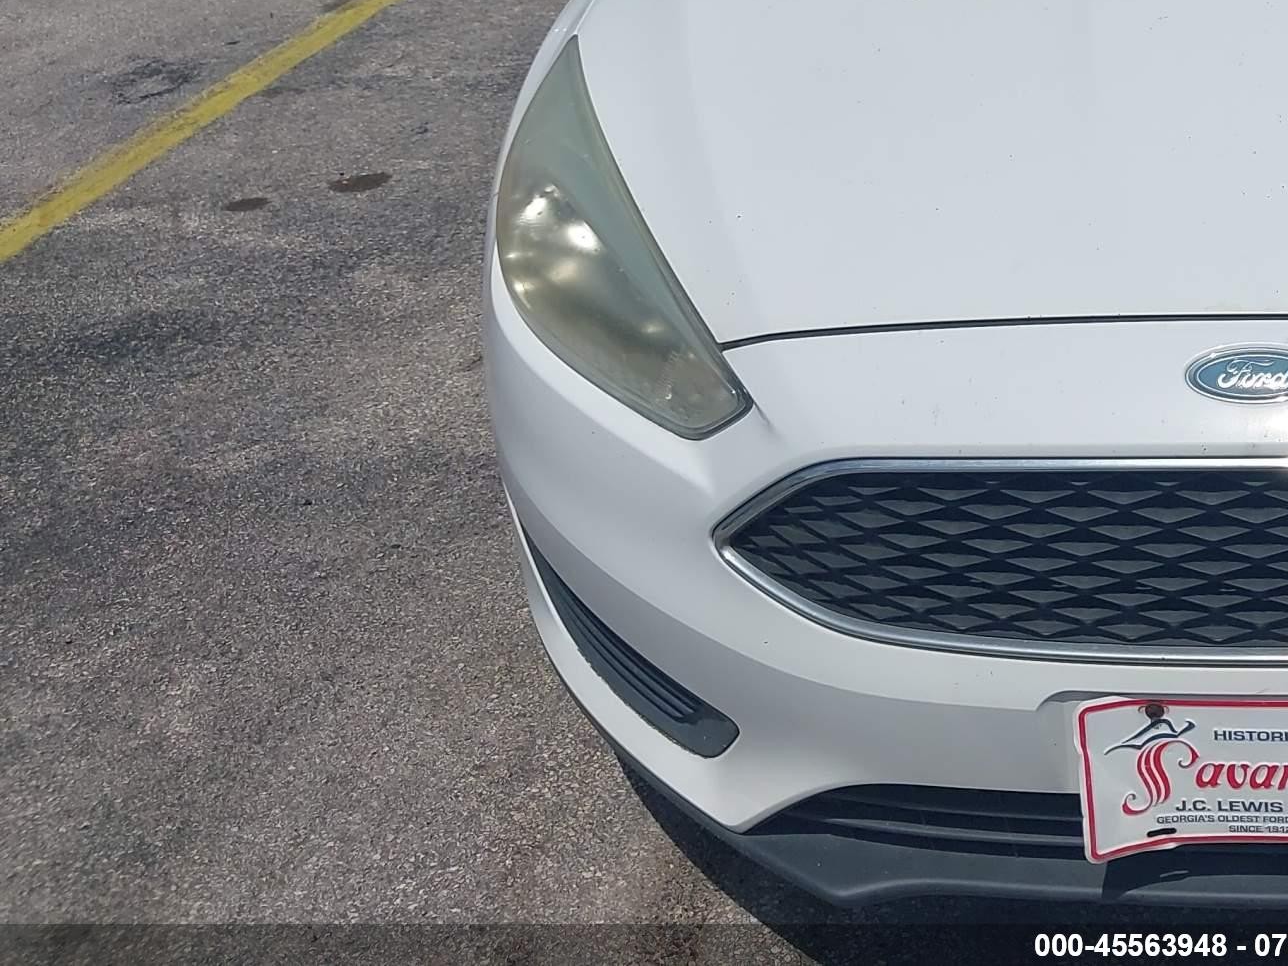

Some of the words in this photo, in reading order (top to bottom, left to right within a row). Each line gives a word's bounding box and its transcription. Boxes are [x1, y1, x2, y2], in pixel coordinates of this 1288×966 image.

[1175, 799, 1211, 812] J.C.
[1217, 800, 1284, 813] LEWIS
[1156, 814, 1215, 824] GEORGIA'S
[1217, 815, 1260, 824] OLDEST
[1228, 825, 1263, 833] SINCE
